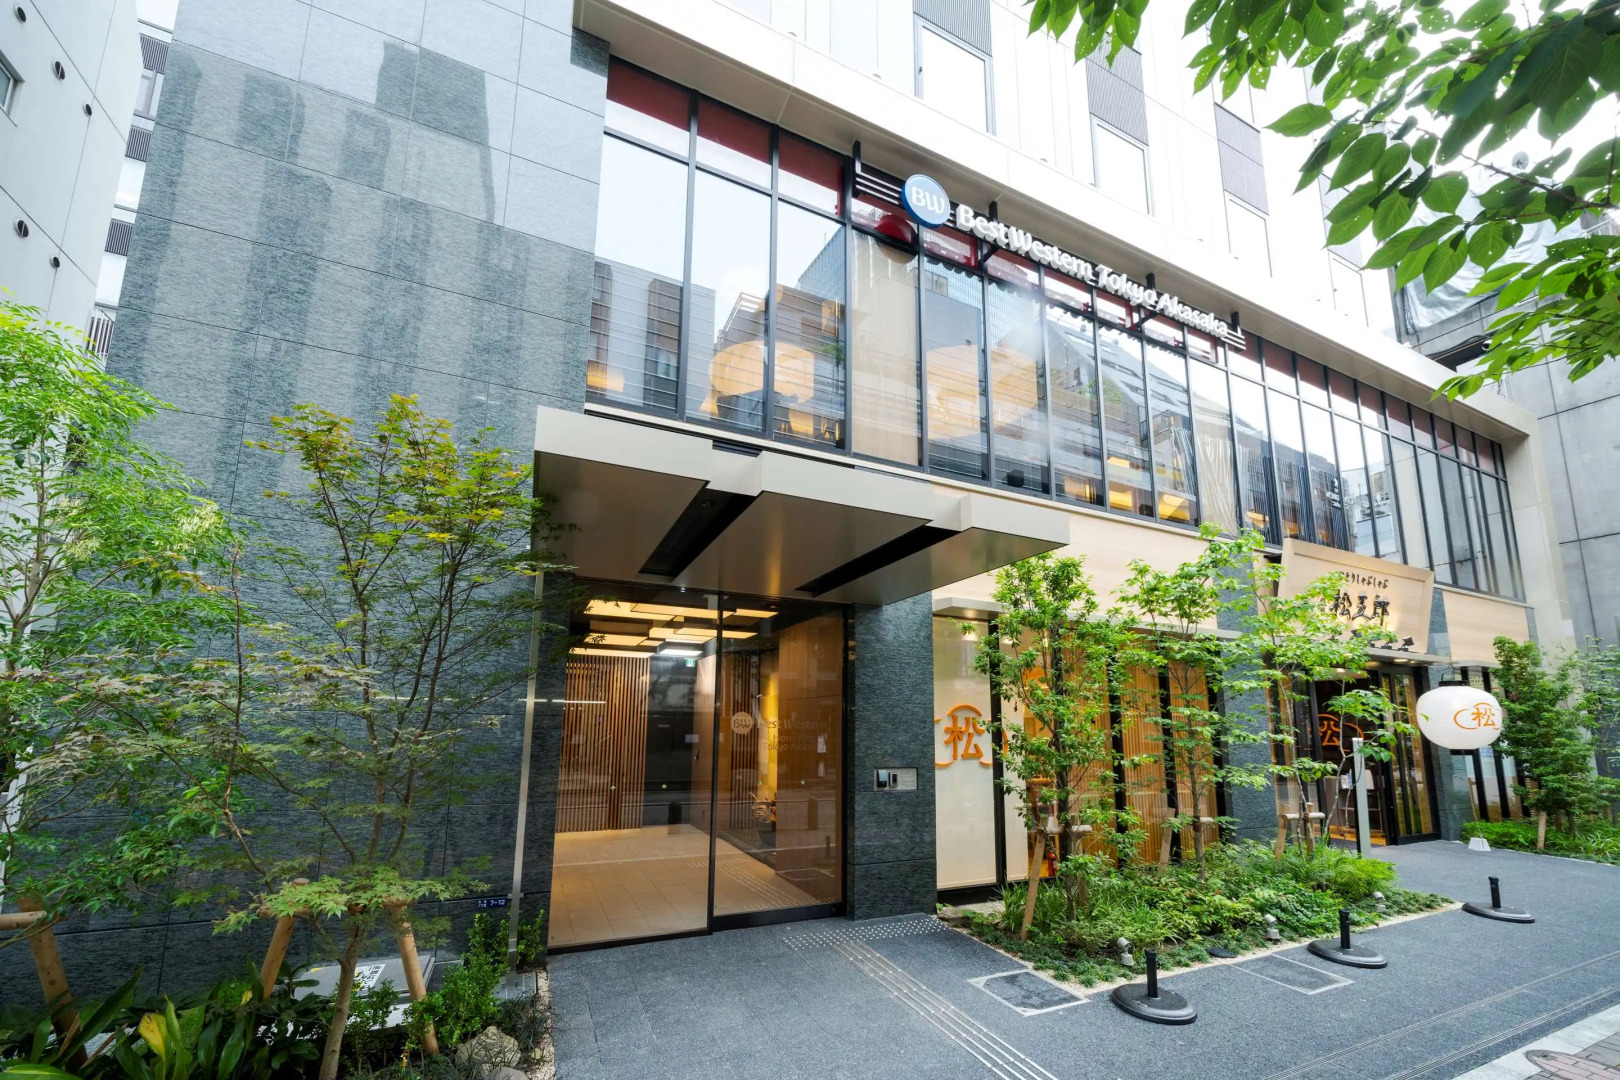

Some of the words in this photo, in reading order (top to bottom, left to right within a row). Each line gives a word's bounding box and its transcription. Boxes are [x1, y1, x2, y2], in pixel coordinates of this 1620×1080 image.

[911, 186, 945, 215] BW
[956, 203, 1008, 248] Best
[1007, 225, 1096, 284] Western
[1095, 263, 1157, 307] Tokyo
[1155, 293, 1229, 338] Akasaka
[1471, 706, 1496, 727] 松
[944, 714, 987, 761] 松
